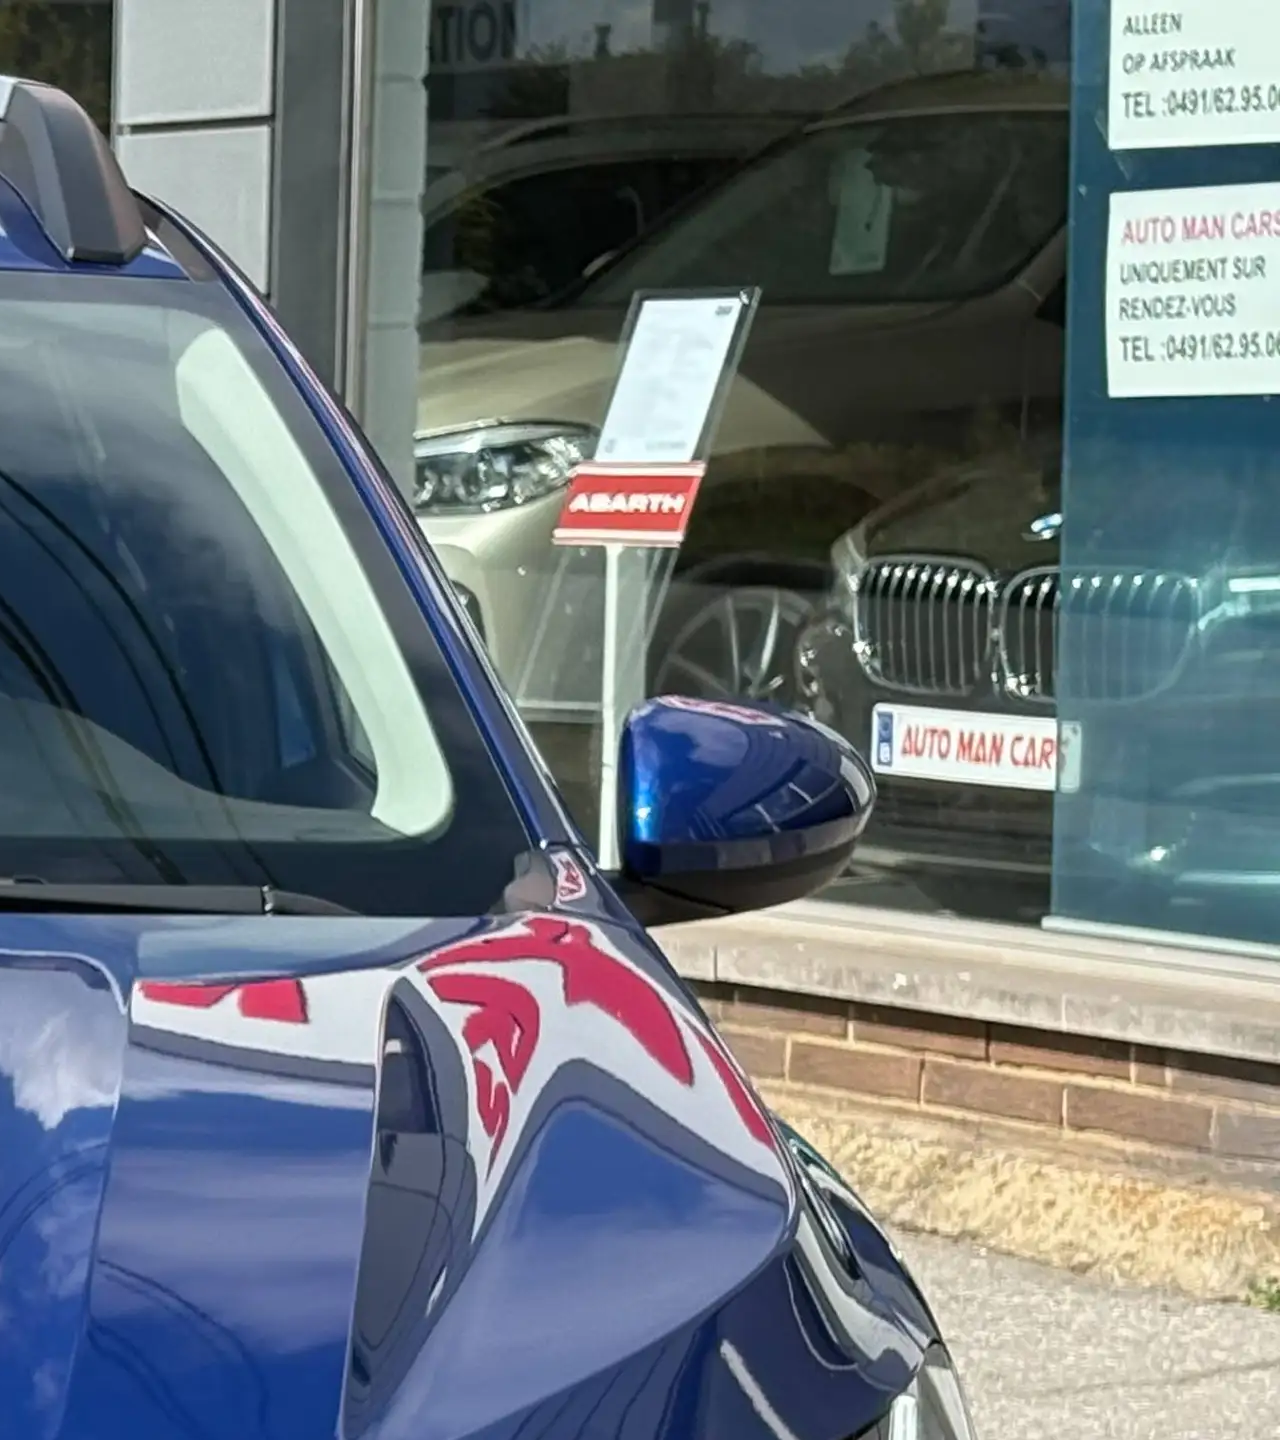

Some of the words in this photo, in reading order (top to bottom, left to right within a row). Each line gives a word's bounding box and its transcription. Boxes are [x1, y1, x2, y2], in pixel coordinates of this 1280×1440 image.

[1123, 12, 1182, 35] ALLEEN
[1122, 52, 1146, 74] OP
[1150, 47, 1236, 72] AFSPRAAK
[1121, 90, 1155, 118] TEL
[1161, 84, 1280, 117] :0491/62.95.0
[1121, 216, 1176, 246] AUTO
[1181, 213, 1226, 242] MAN
[1119, 257, 1228, 285] UNIQUEMENT
[1232, 255, 1267, 280] SUR
[1119, 293, 1237, 321] RENDEZ-VOUS
[1119, 335, 1155, 362] TEL
[568, 491, 686, 513] ABARTH
[901, 724, 951, 759] AUTO
[956, 729, 1004, 767] MAN
